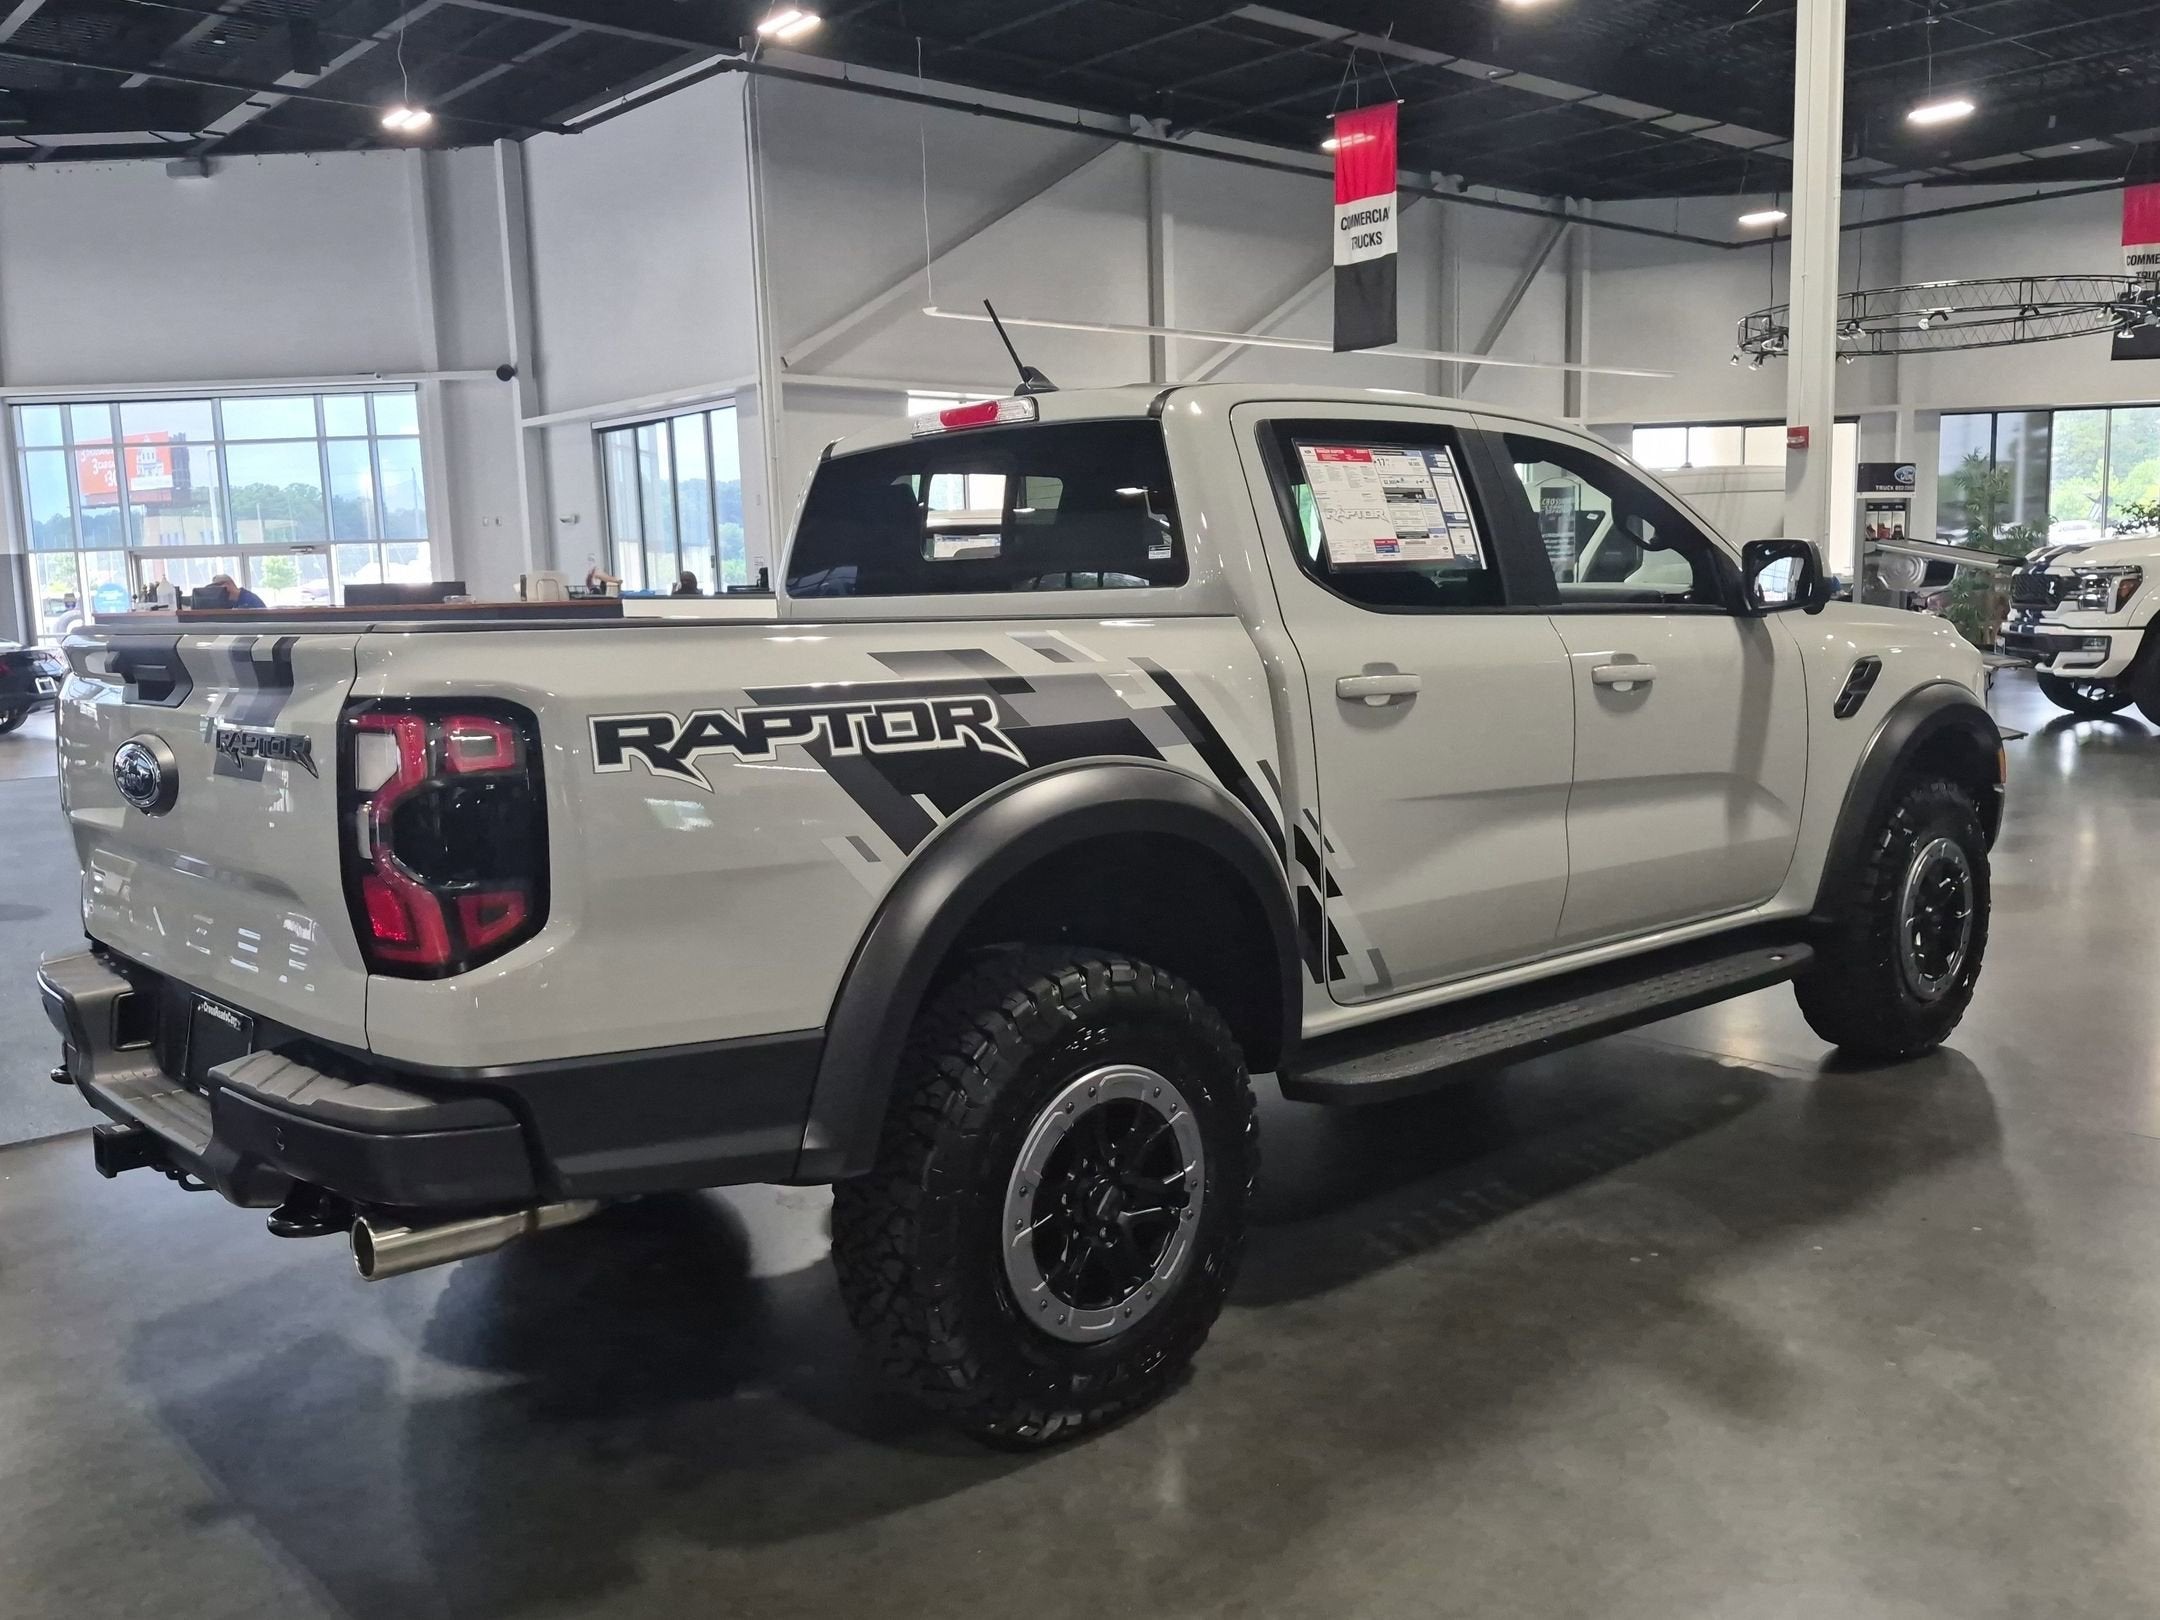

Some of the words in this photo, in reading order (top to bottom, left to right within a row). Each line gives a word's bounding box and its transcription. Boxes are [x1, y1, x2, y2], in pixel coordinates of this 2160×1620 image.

[1340, 206, 1391, 231] CMERCIA
[1351, 231, 1383, 250] RUCKS
[216, 728, 319, 779] RAPTOR
[586, 694, 1029, 794] RAPTOR
